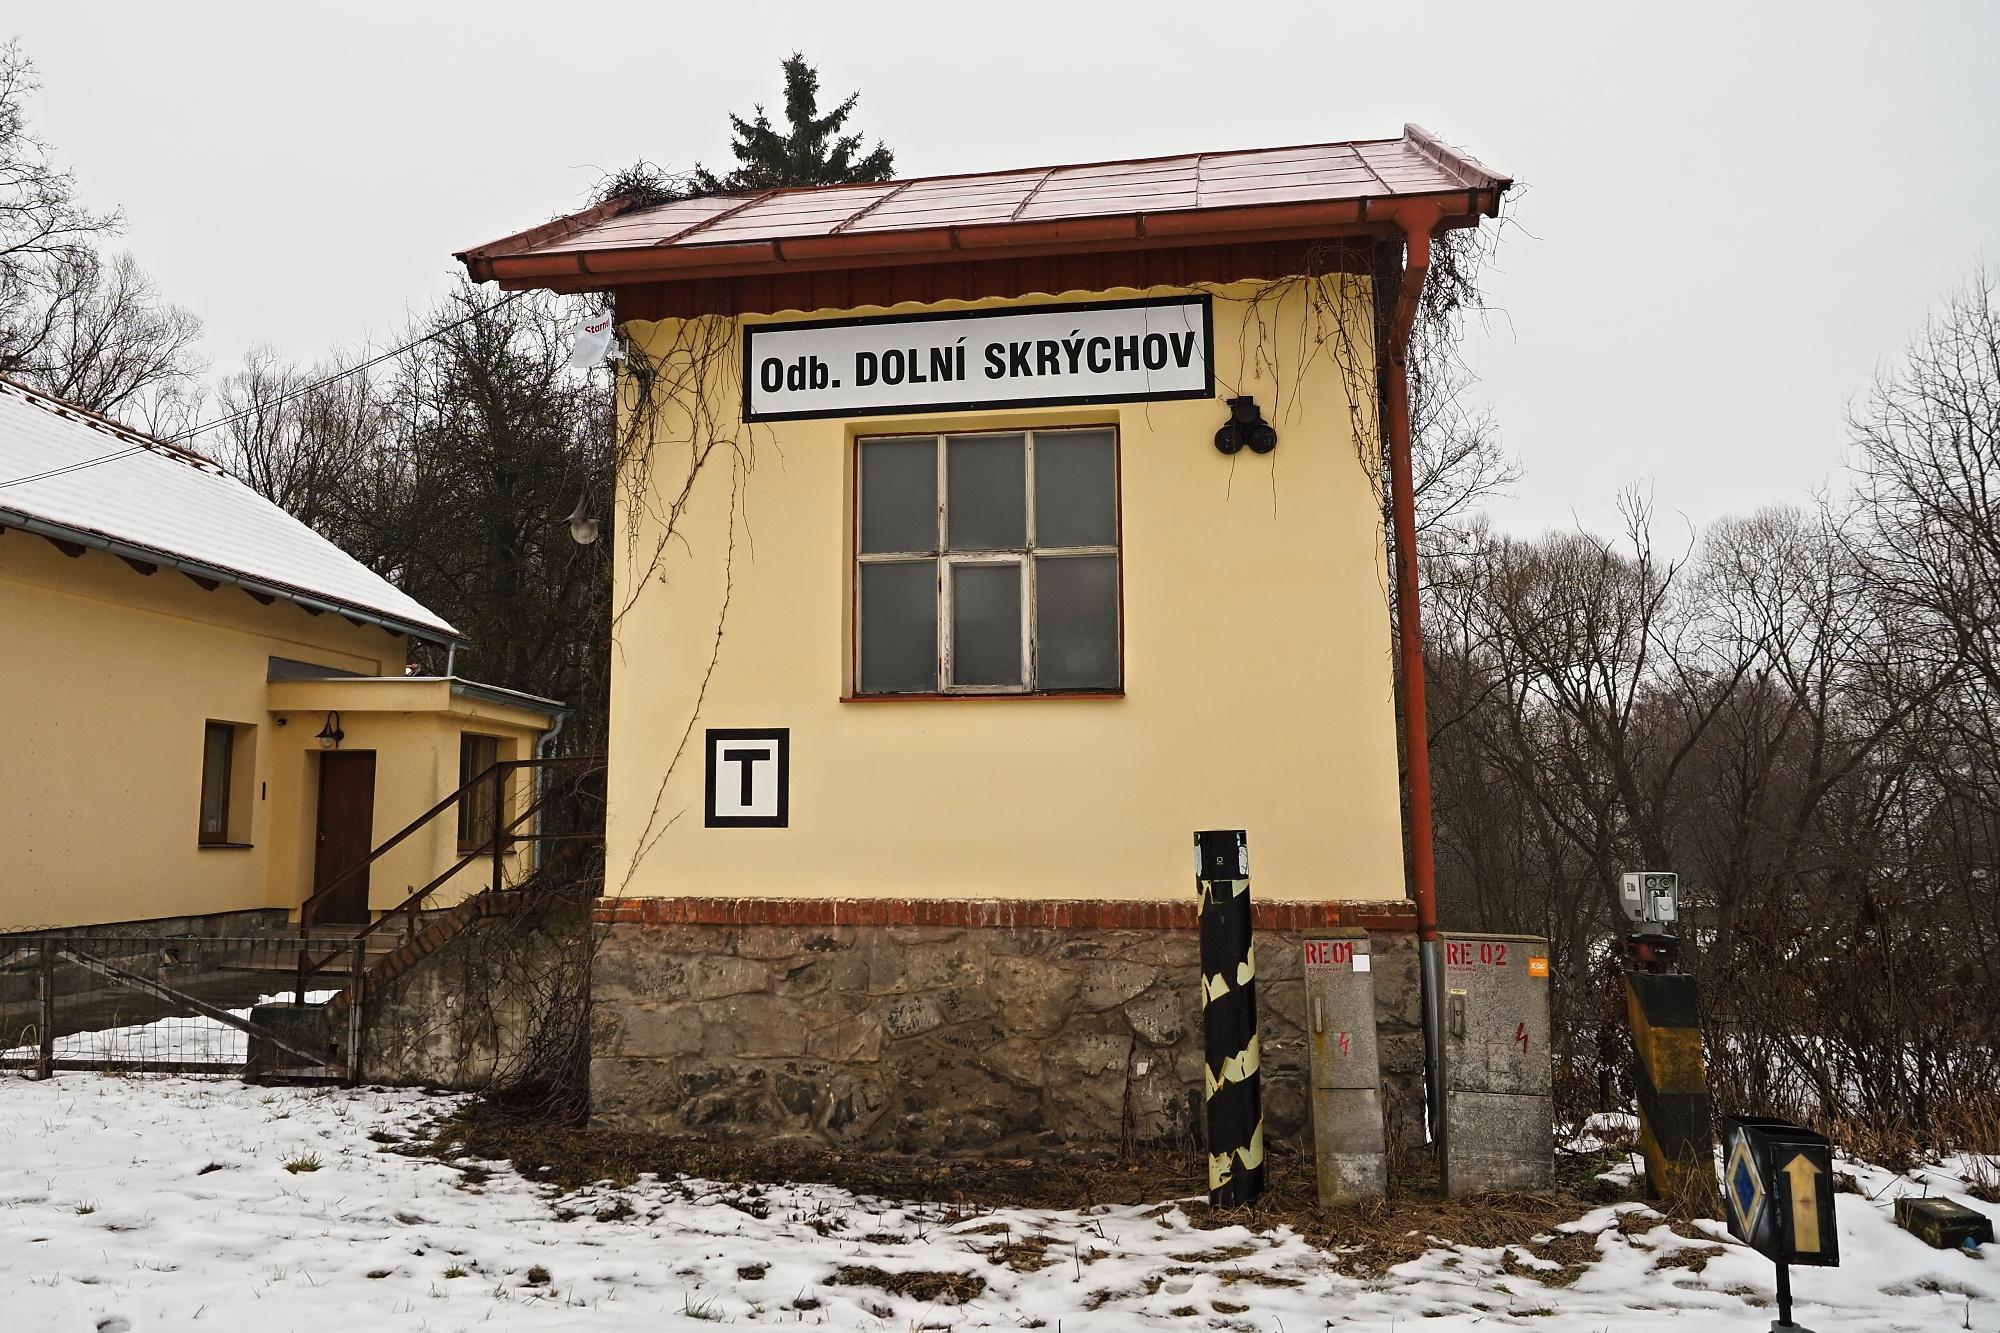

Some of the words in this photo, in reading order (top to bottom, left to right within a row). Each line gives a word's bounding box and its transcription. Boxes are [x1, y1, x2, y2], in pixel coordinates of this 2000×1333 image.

[760, 355, 841, 393] Odb.
[855, 336, 968, 387] DOLNÍ
[984, 329, 1196, 380] SKRÝCHOV
[724, 748, 770, 806] T
[1446, 943, 1473, 965] RE
[1480, 943, 1507, 966] 02
